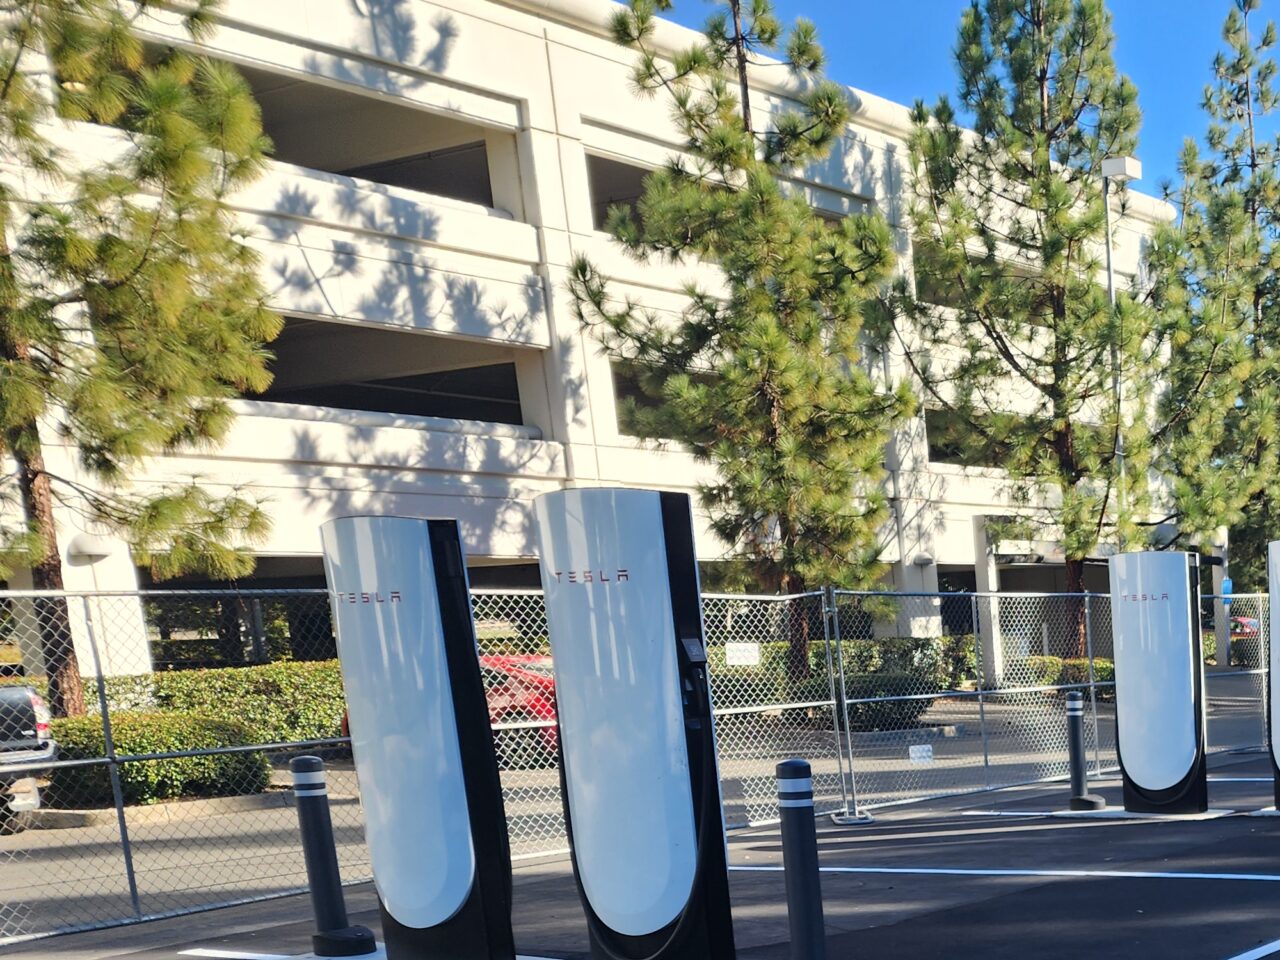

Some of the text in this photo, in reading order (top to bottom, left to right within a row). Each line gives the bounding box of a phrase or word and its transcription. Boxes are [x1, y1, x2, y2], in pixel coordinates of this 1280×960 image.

[555, 569, 629, 583] TESLA
[338, 591, 401, 603] TESLA
[1122, 593, 1169, 602] TESLA
